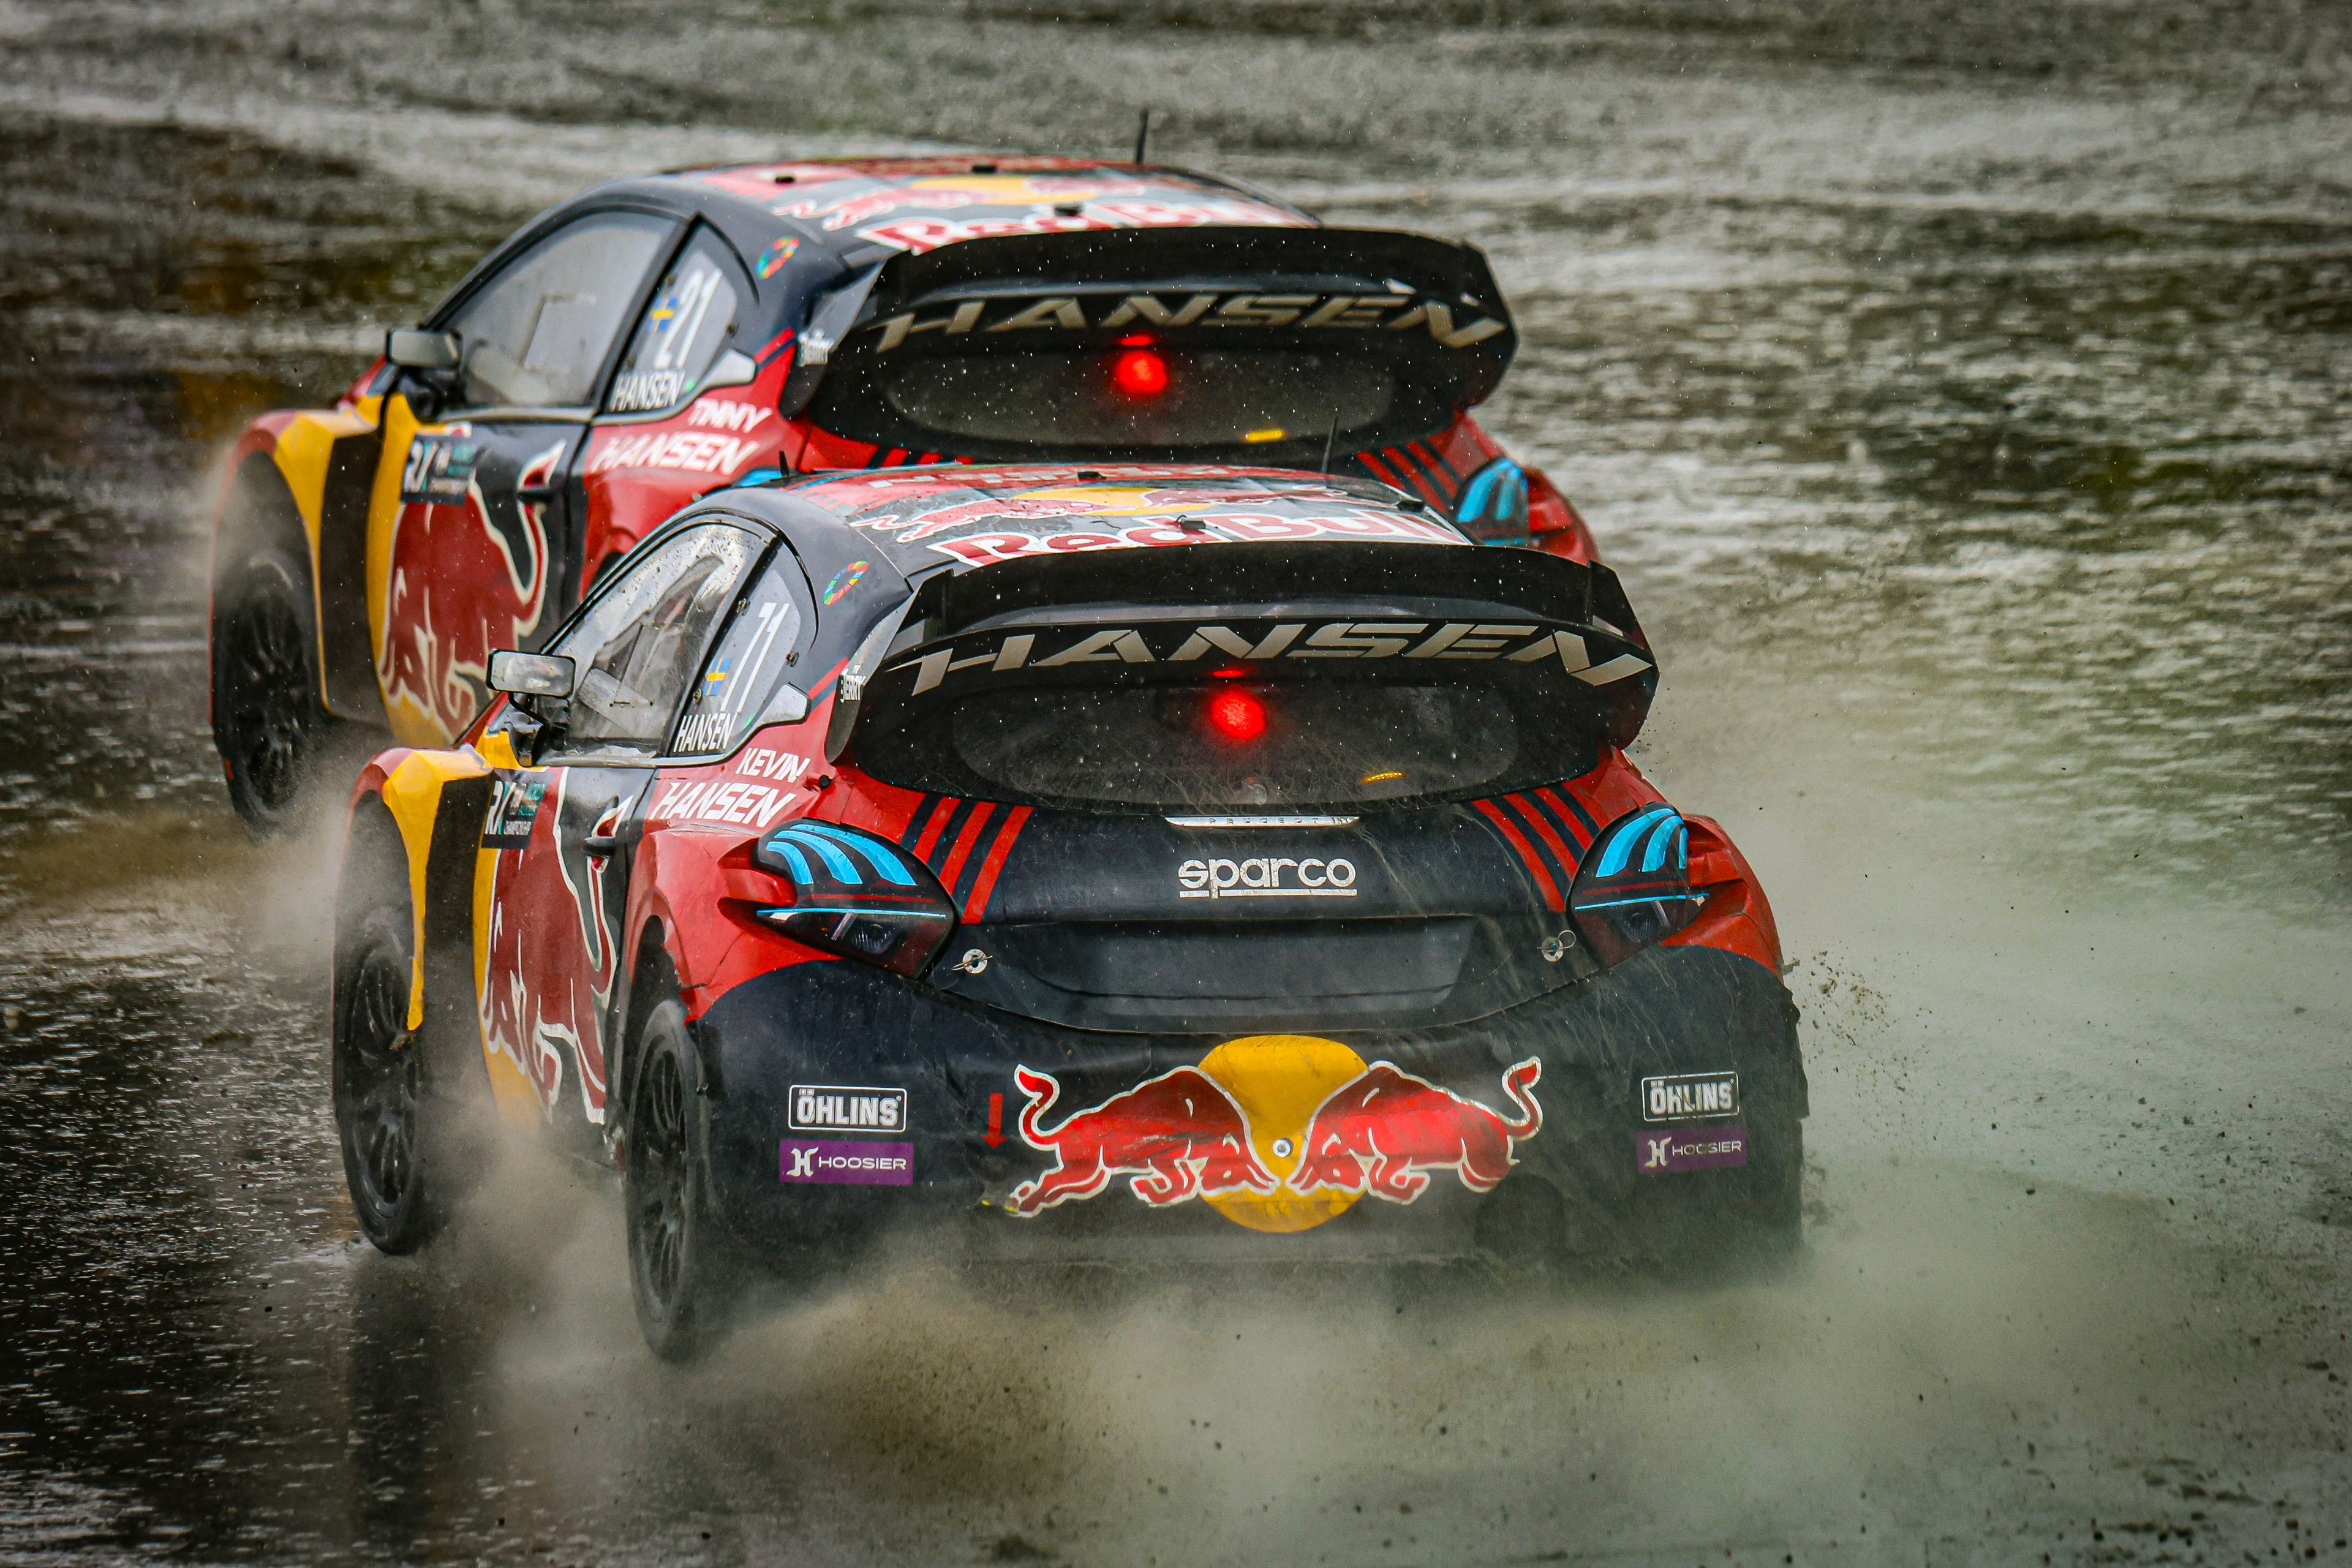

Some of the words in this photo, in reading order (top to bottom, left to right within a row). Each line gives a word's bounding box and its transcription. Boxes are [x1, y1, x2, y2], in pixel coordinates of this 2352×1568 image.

[1083, 199, 1316, 228] Bu
[655, 268, 723, 369] 21
[859, 293, 1507, 353] HANSEN
[610, 371, 685, 412] HANSEN
[589, 431, 760, 475] HANSEN
[926, 514, 1233, 567] Red
[1193, 509, 1472, 545] Bull
[720, 602, 790, 715] 71
[884, 622, 1653, 695] HANSEN
[674, 712, 739, 752] HANSEN
[736, 747, 810, 783] KEVIN
[649, 782, 797, 827] HANSEN
[1178, 858, 1356, 899] sparco
[797, 1088, 899, 1126] ÖHLINS
[1650, 1079, 1733, 1115] ÖHLINS
[818, 1156, 907, 1170] HOOSIER
[1672, 1140, 1741, 1156] HOOSIER
